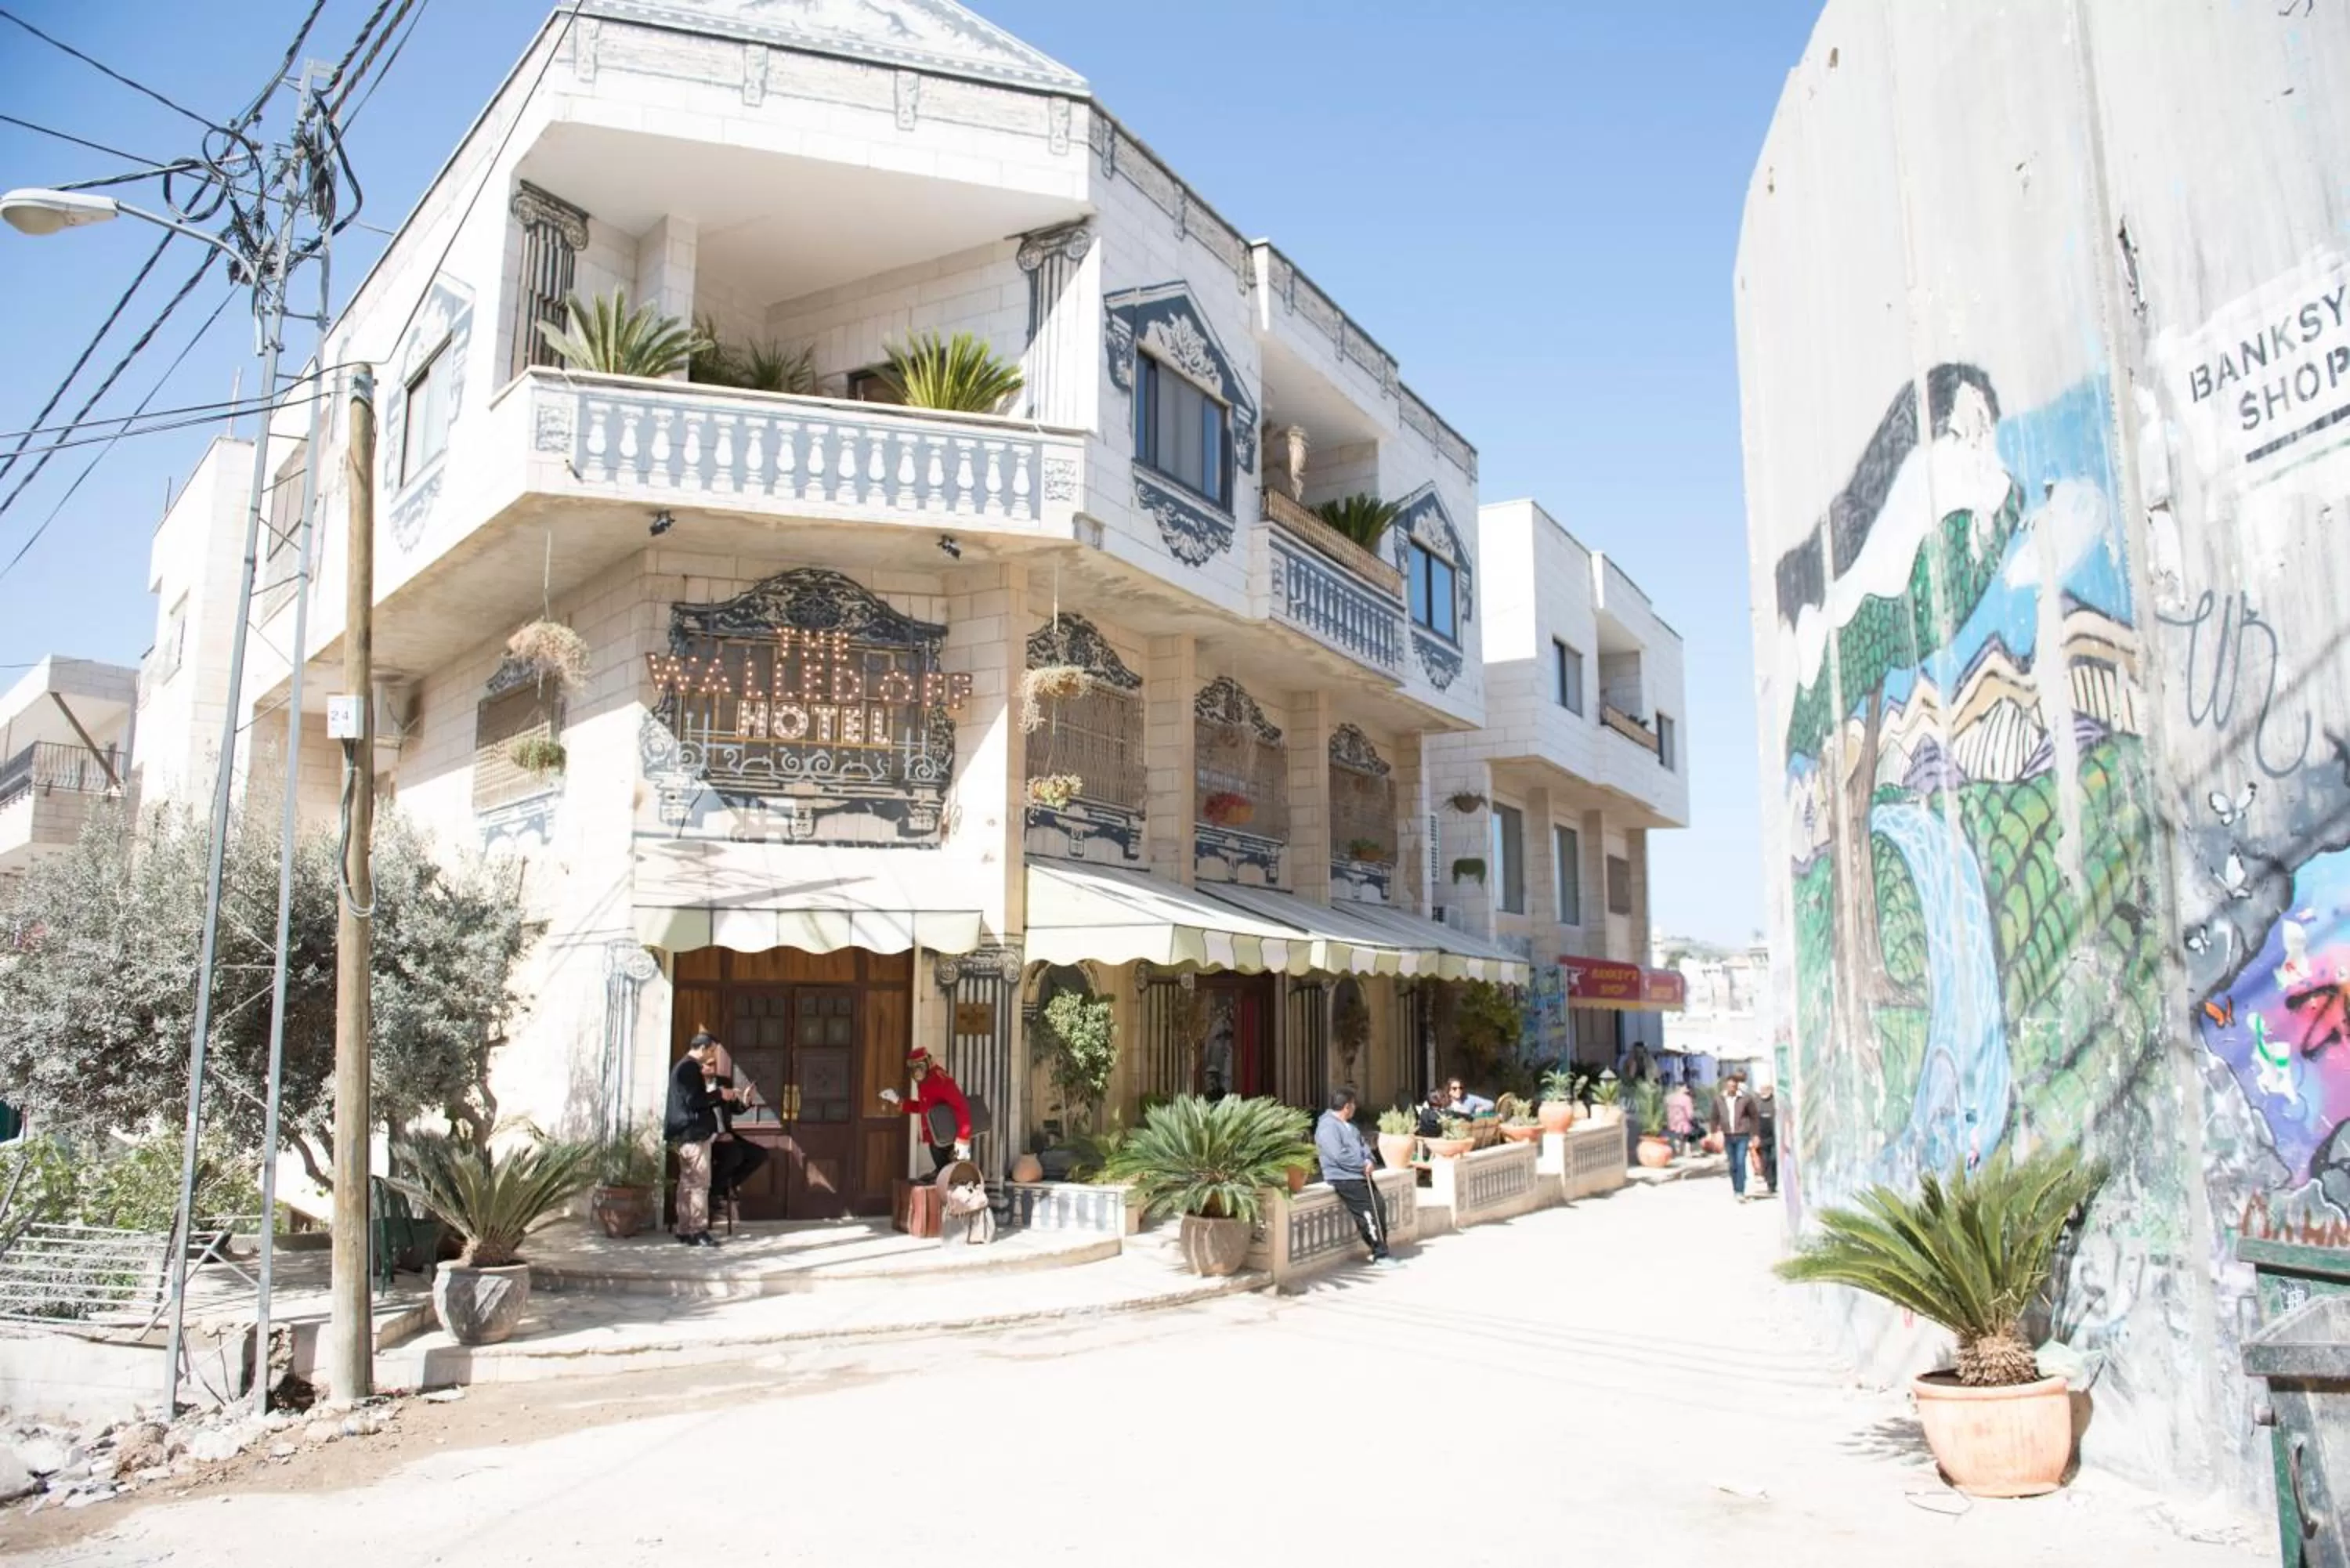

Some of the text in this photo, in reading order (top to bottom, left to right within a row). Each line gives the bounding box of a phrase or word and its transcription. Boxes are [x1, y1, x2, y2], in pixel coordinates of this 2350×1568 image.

[2189, 284, 2346, 403] BANKSY
[2239, 345, 2350, 431] SHOP
[777, 627, 849, 662] THE
[645, 652, 973, 710] WALLED OFF
[736, 699, 891, 746] HOTEL
